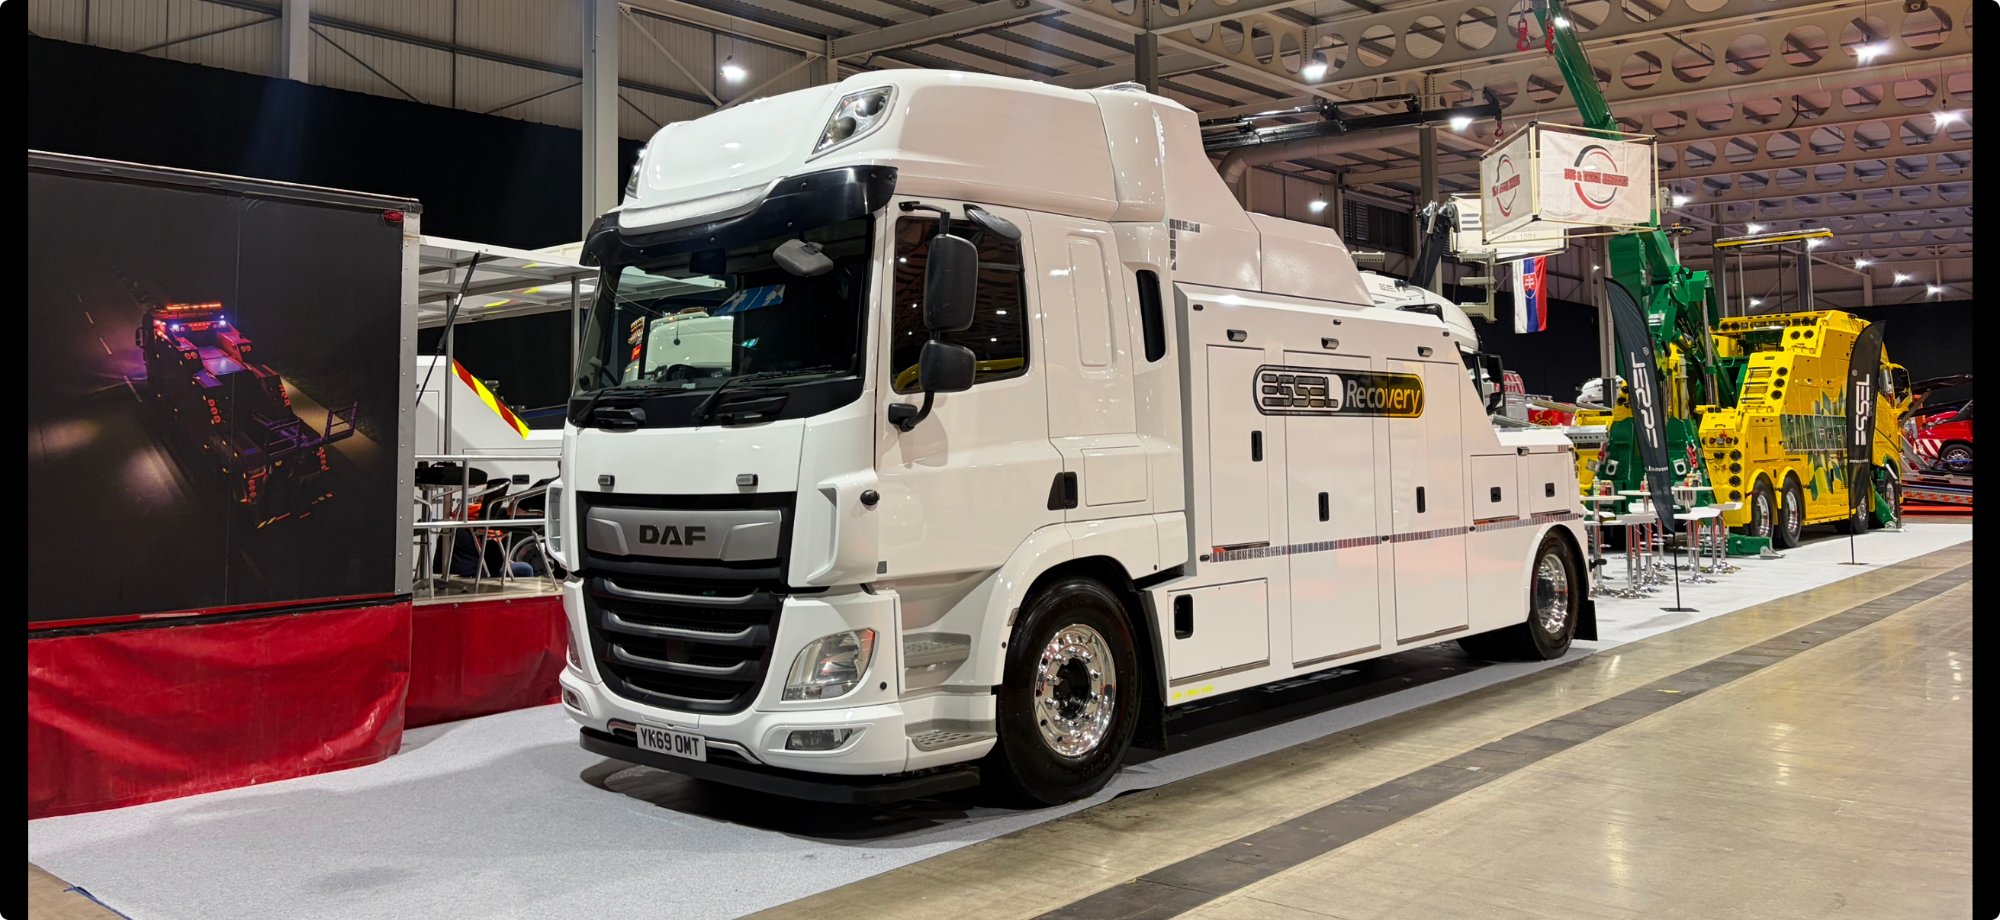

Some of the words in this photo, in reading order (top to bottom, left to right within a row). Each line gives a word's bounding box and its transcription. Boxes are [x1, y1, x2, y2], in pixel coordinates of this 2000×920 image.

[1261, 373, 1339, 409] ESSEL
[1345, 379, 1421, 415] Recovery
[639, 524, 706, 546] DAF
[640, 727, 672, 751] YK69
[675, 734, 699, 757] OMT
